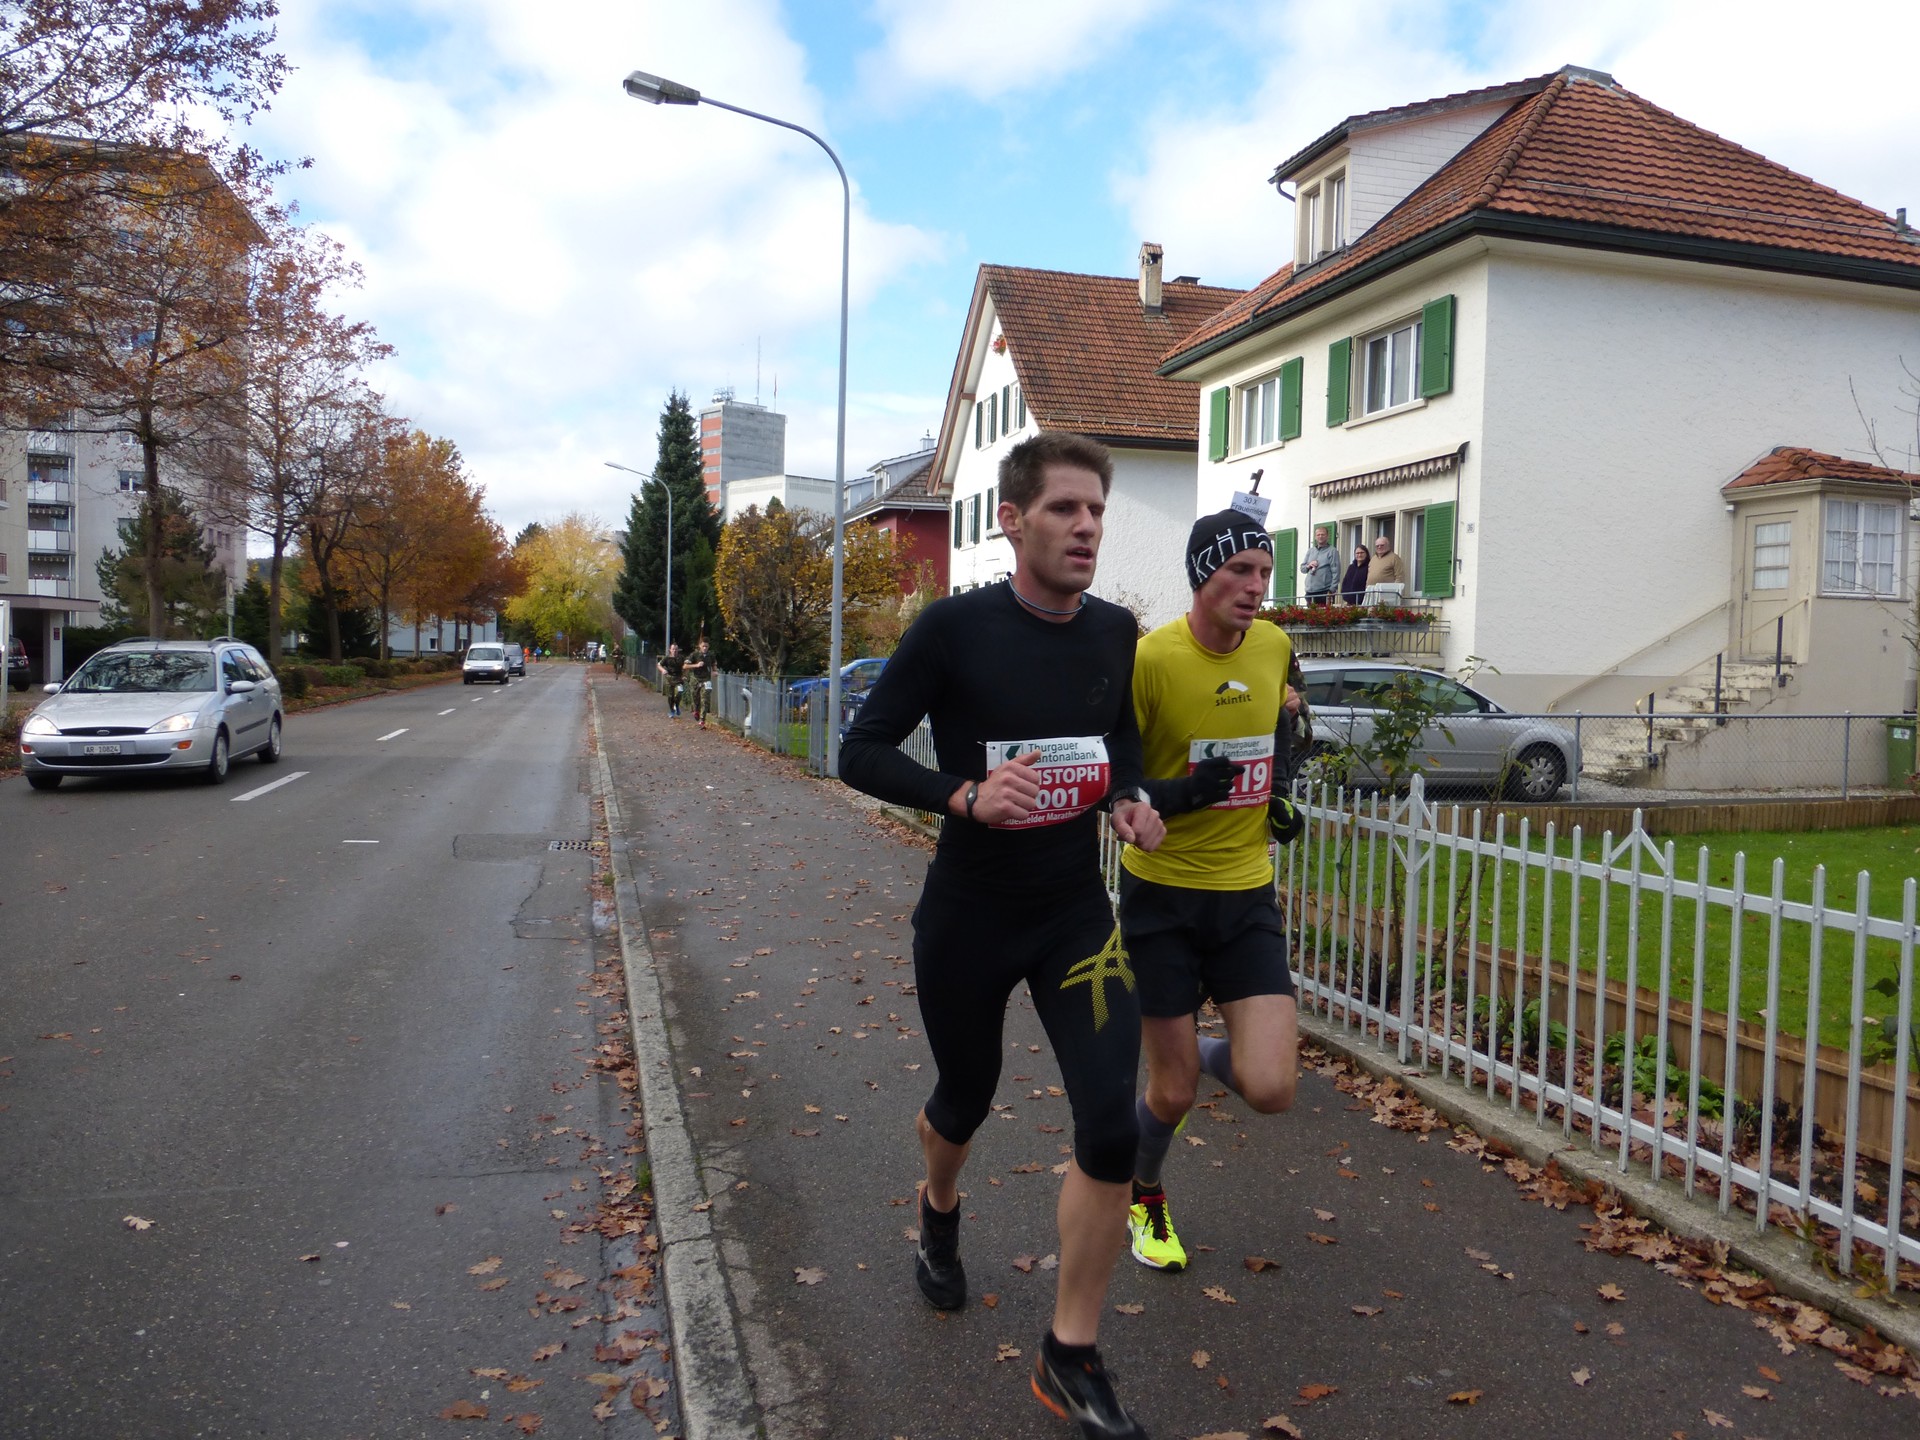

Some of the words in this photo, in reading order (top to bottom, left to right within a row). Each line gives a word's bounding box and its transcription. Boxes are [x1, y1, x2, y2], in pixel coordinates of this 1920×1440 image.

[1243, 496, 1252, 504] 30
[1215, 693, 1252, 707] skinfit
[1028, 742, 1079, 753] Thurgauer
[1221, 746, 1269, 758] Kantonalbank
[1222, 741, 1260, 751] Thurgauer
[1037, 750, 1098, 763] antonalbank
[1038, 765, 1100, 786] ISTOPH
[1228, 762, 1268, 793] 19
[1034, 787, 1079, 810] 001
